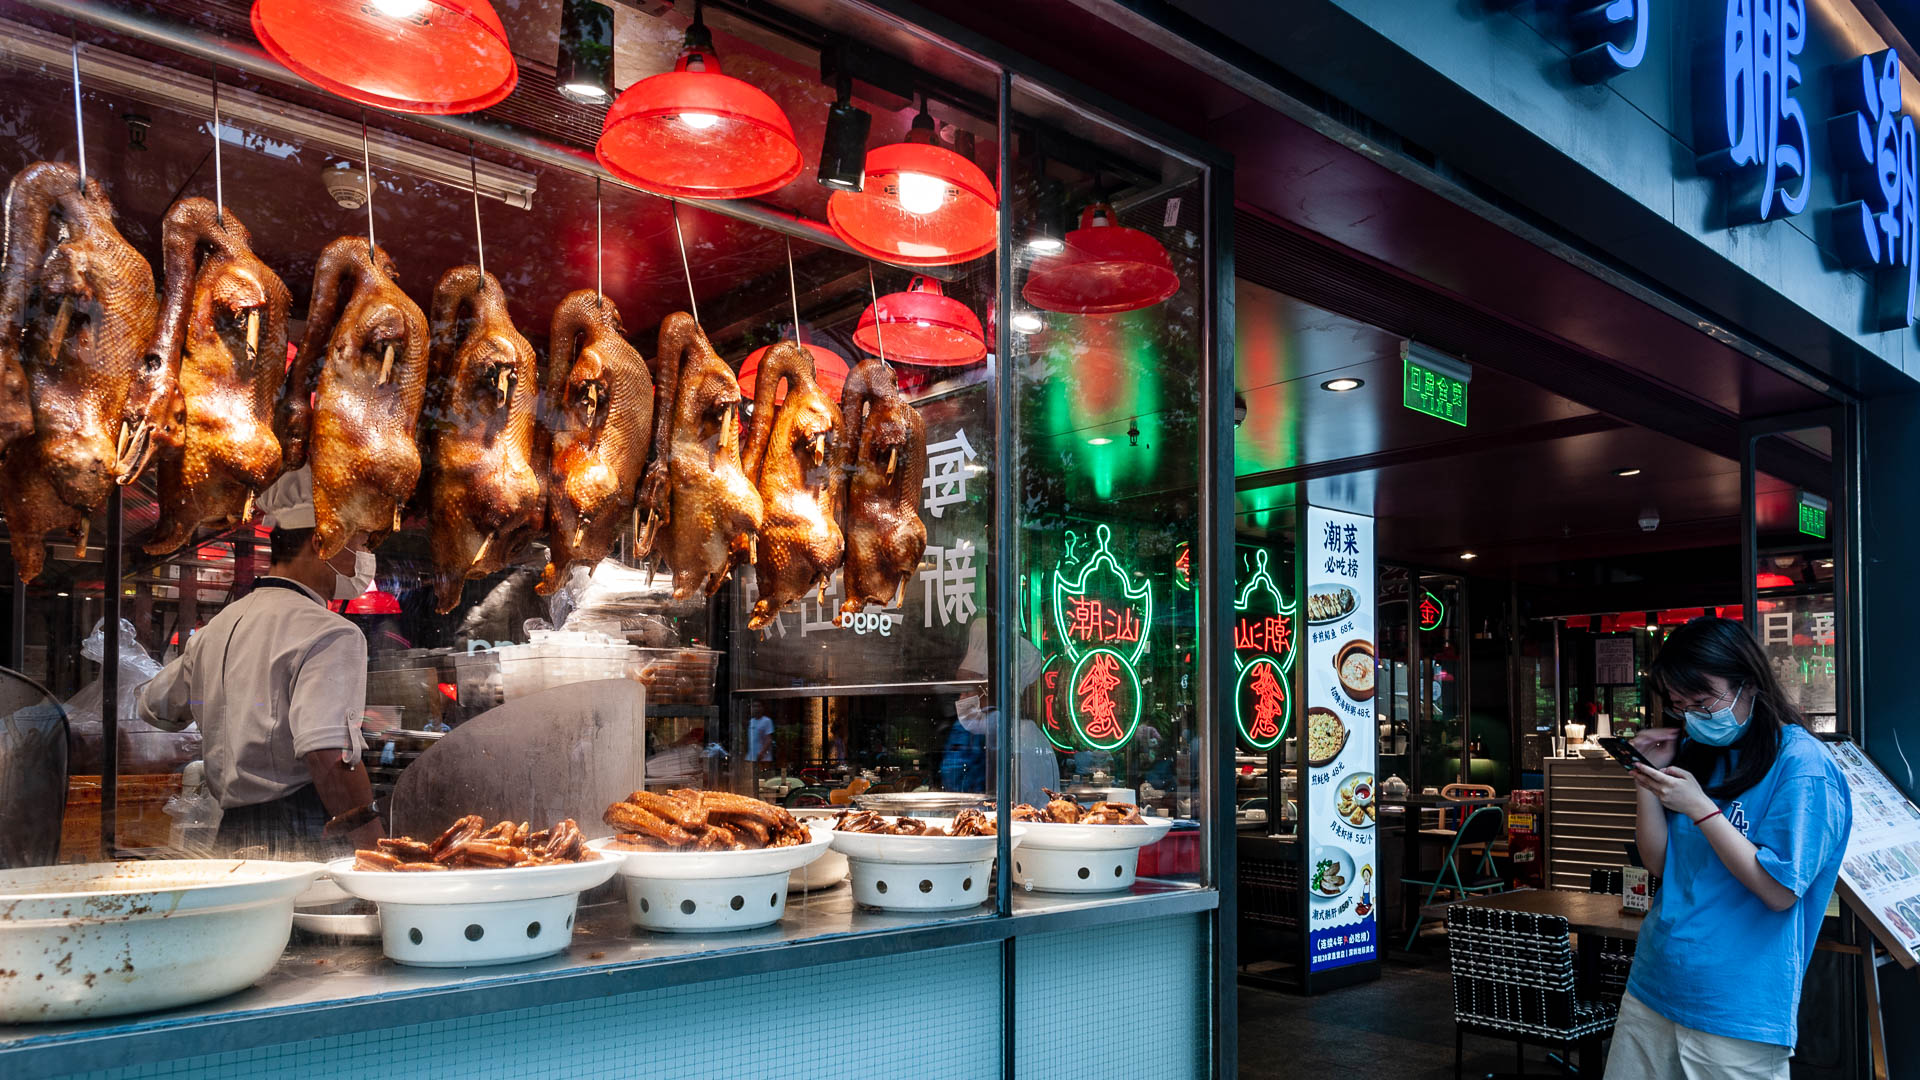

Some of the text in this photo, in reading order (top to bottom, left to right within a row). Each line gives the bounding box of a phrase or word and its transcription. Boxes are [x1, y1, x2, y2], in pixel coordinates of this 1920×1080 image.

[1324, 521, 1359, 555] 潮菜
[1324, 556, 1358, 579] 必吃榜
[1067, 595, 1139, 641] 潮汕
